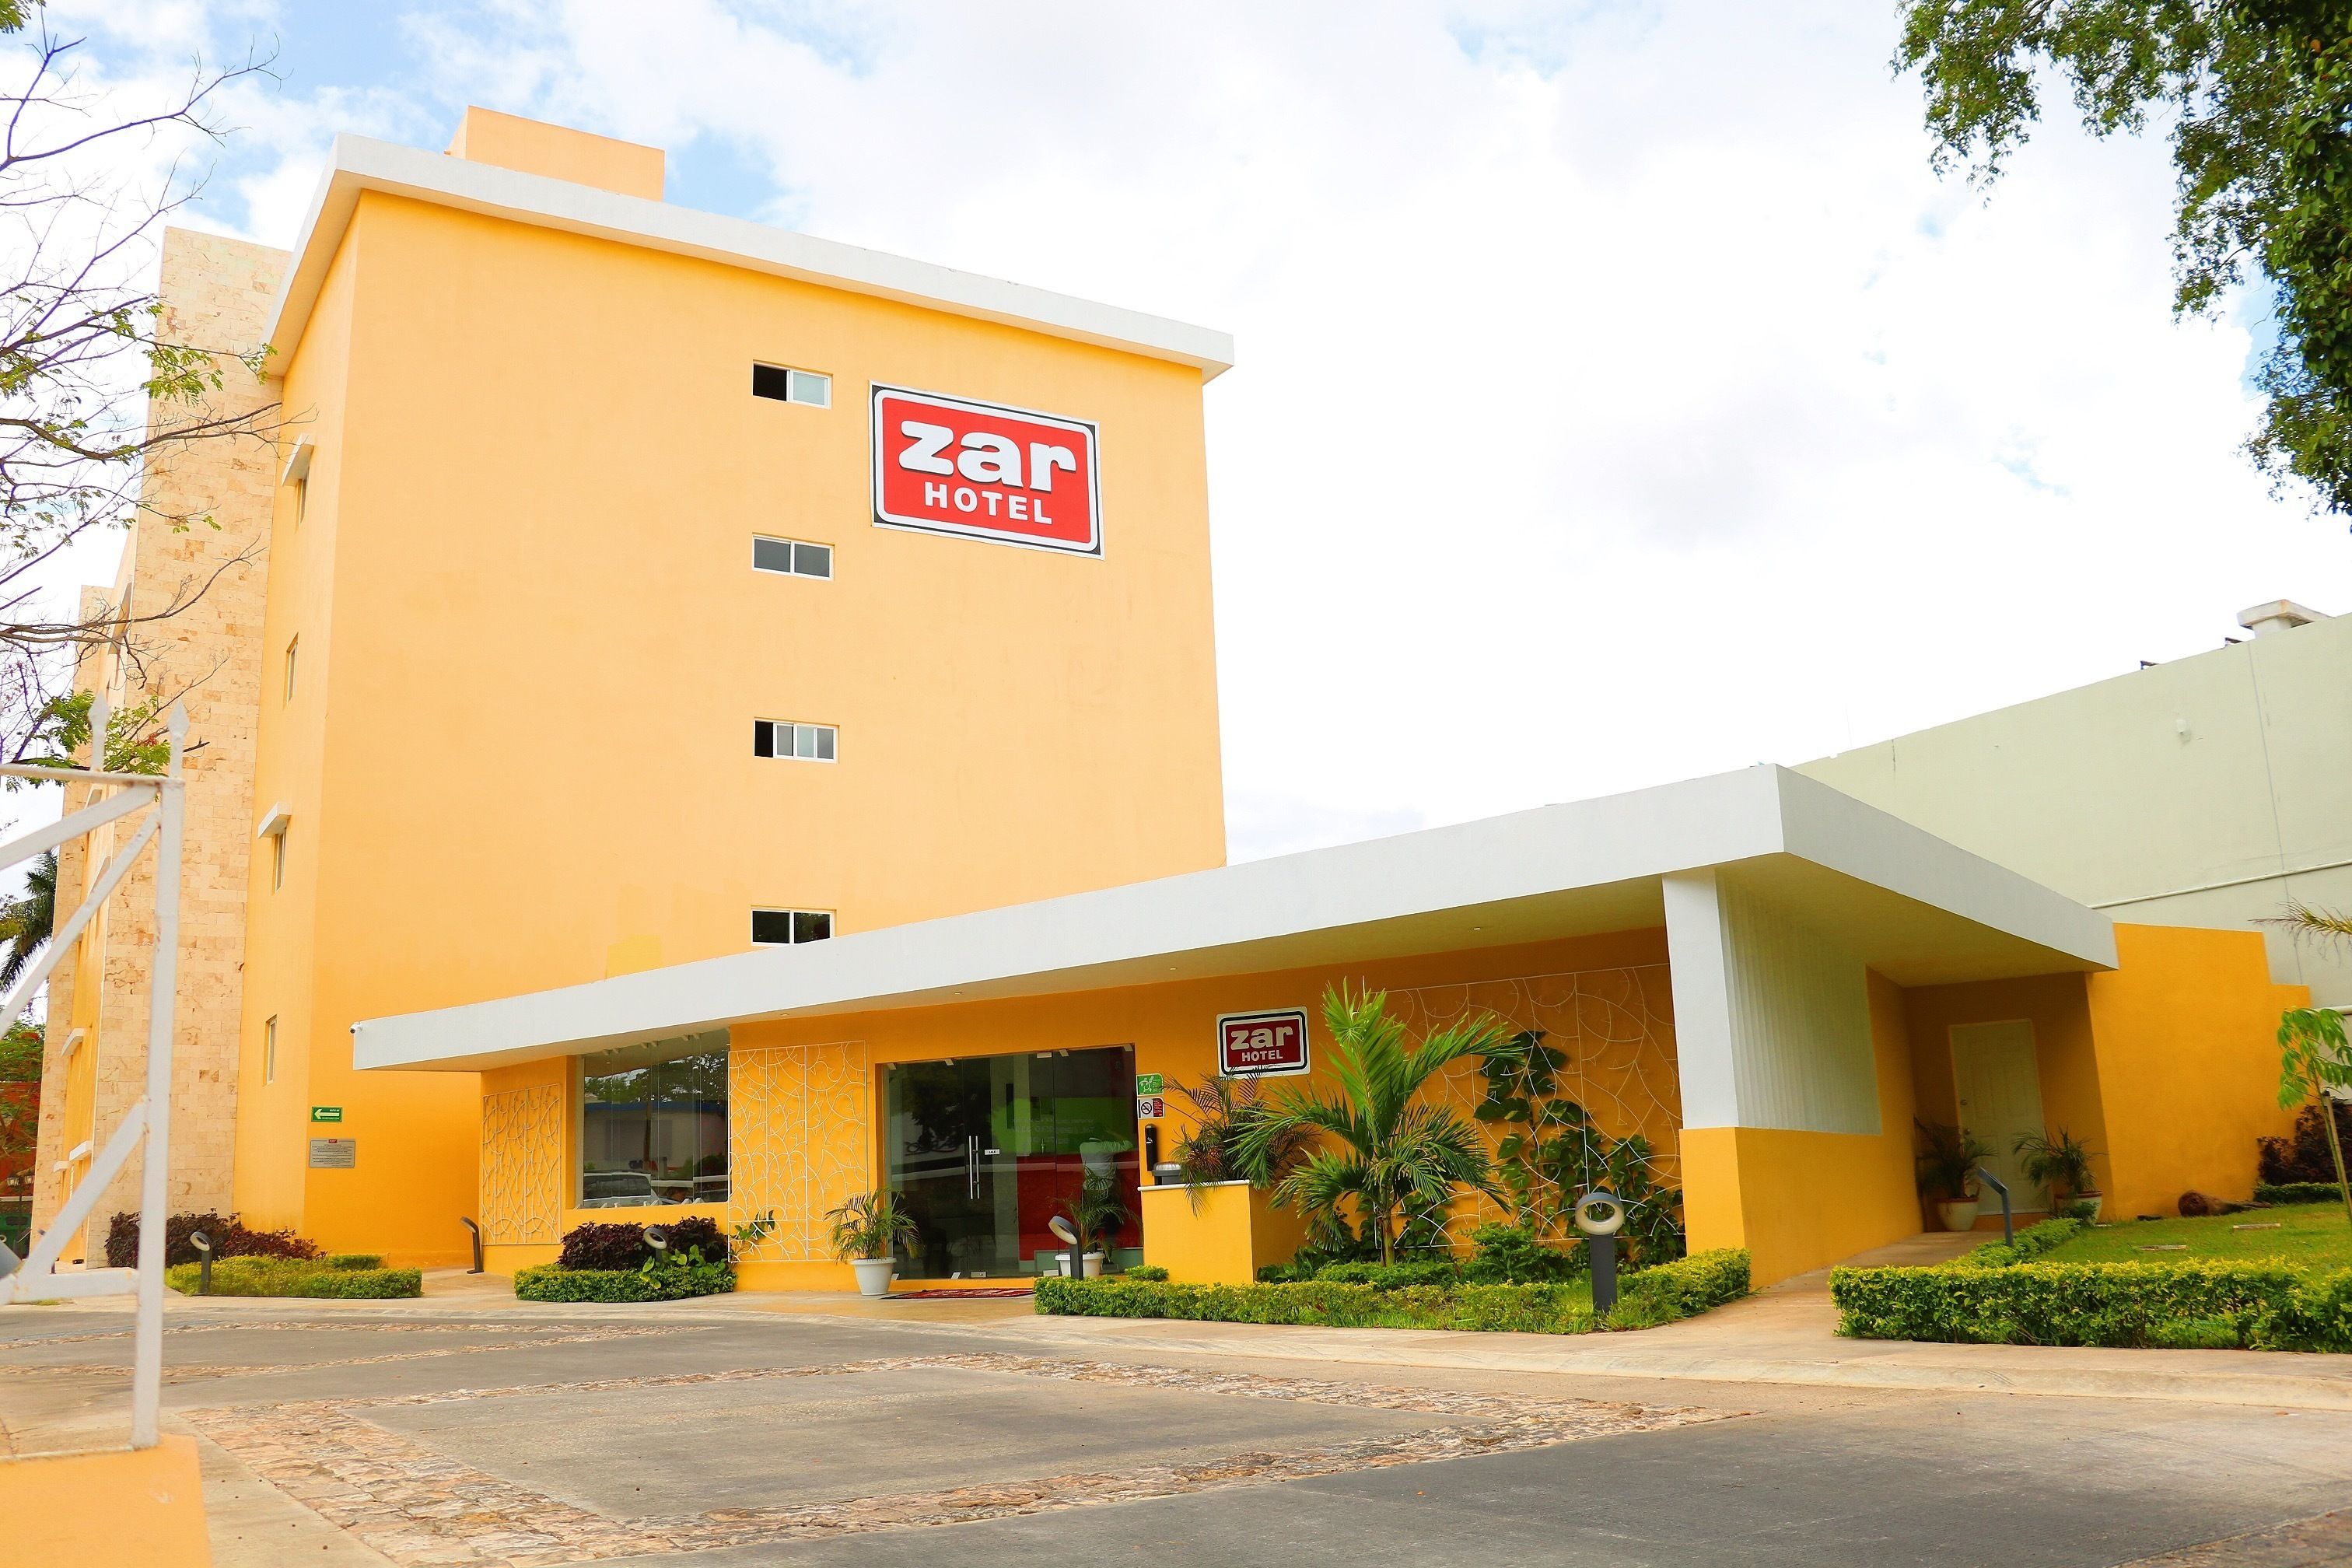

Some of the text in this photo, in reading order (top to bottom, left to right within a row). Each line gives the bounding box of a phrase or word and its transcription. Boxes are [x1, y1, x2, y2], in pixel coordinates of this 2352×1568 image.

[898, 420, 1076, 493] zar
[924, 481, 1052, 525] HOTEL
[1230, 1026, 1293, 1050] zar
[1241, 1050, 1283, 1062] HOTEL
